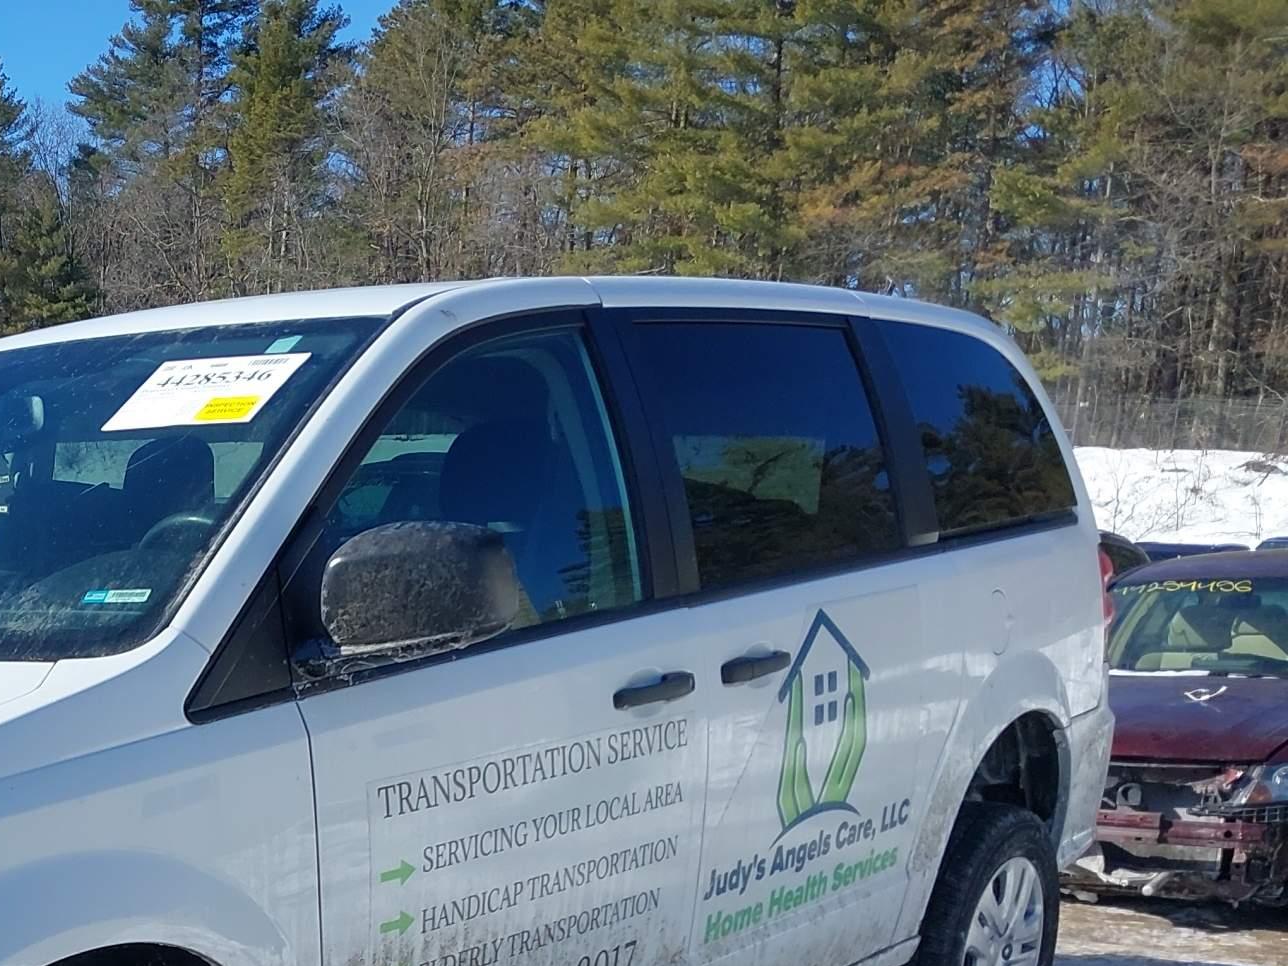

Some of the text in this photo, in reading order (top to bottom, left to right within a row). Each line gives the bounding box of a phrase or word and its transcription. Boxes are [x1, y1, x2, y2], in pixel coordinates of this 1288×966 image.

[156, 369, 273, 387] 44285346
[377, 719, 688, 819] TRANSPORTATION SERVICE
[422, 781, 684, 873] SERVICING YOUR LOCAL AREA
[703, 798, 911, 901] Judy's Angels Care, LLC
[420, 835, 679, 934] HANDICAP TRANSPORTATION
[507, 887, 661, 957] TRANSPORTATION
[703, 847, 899, 945] Home Health Services
